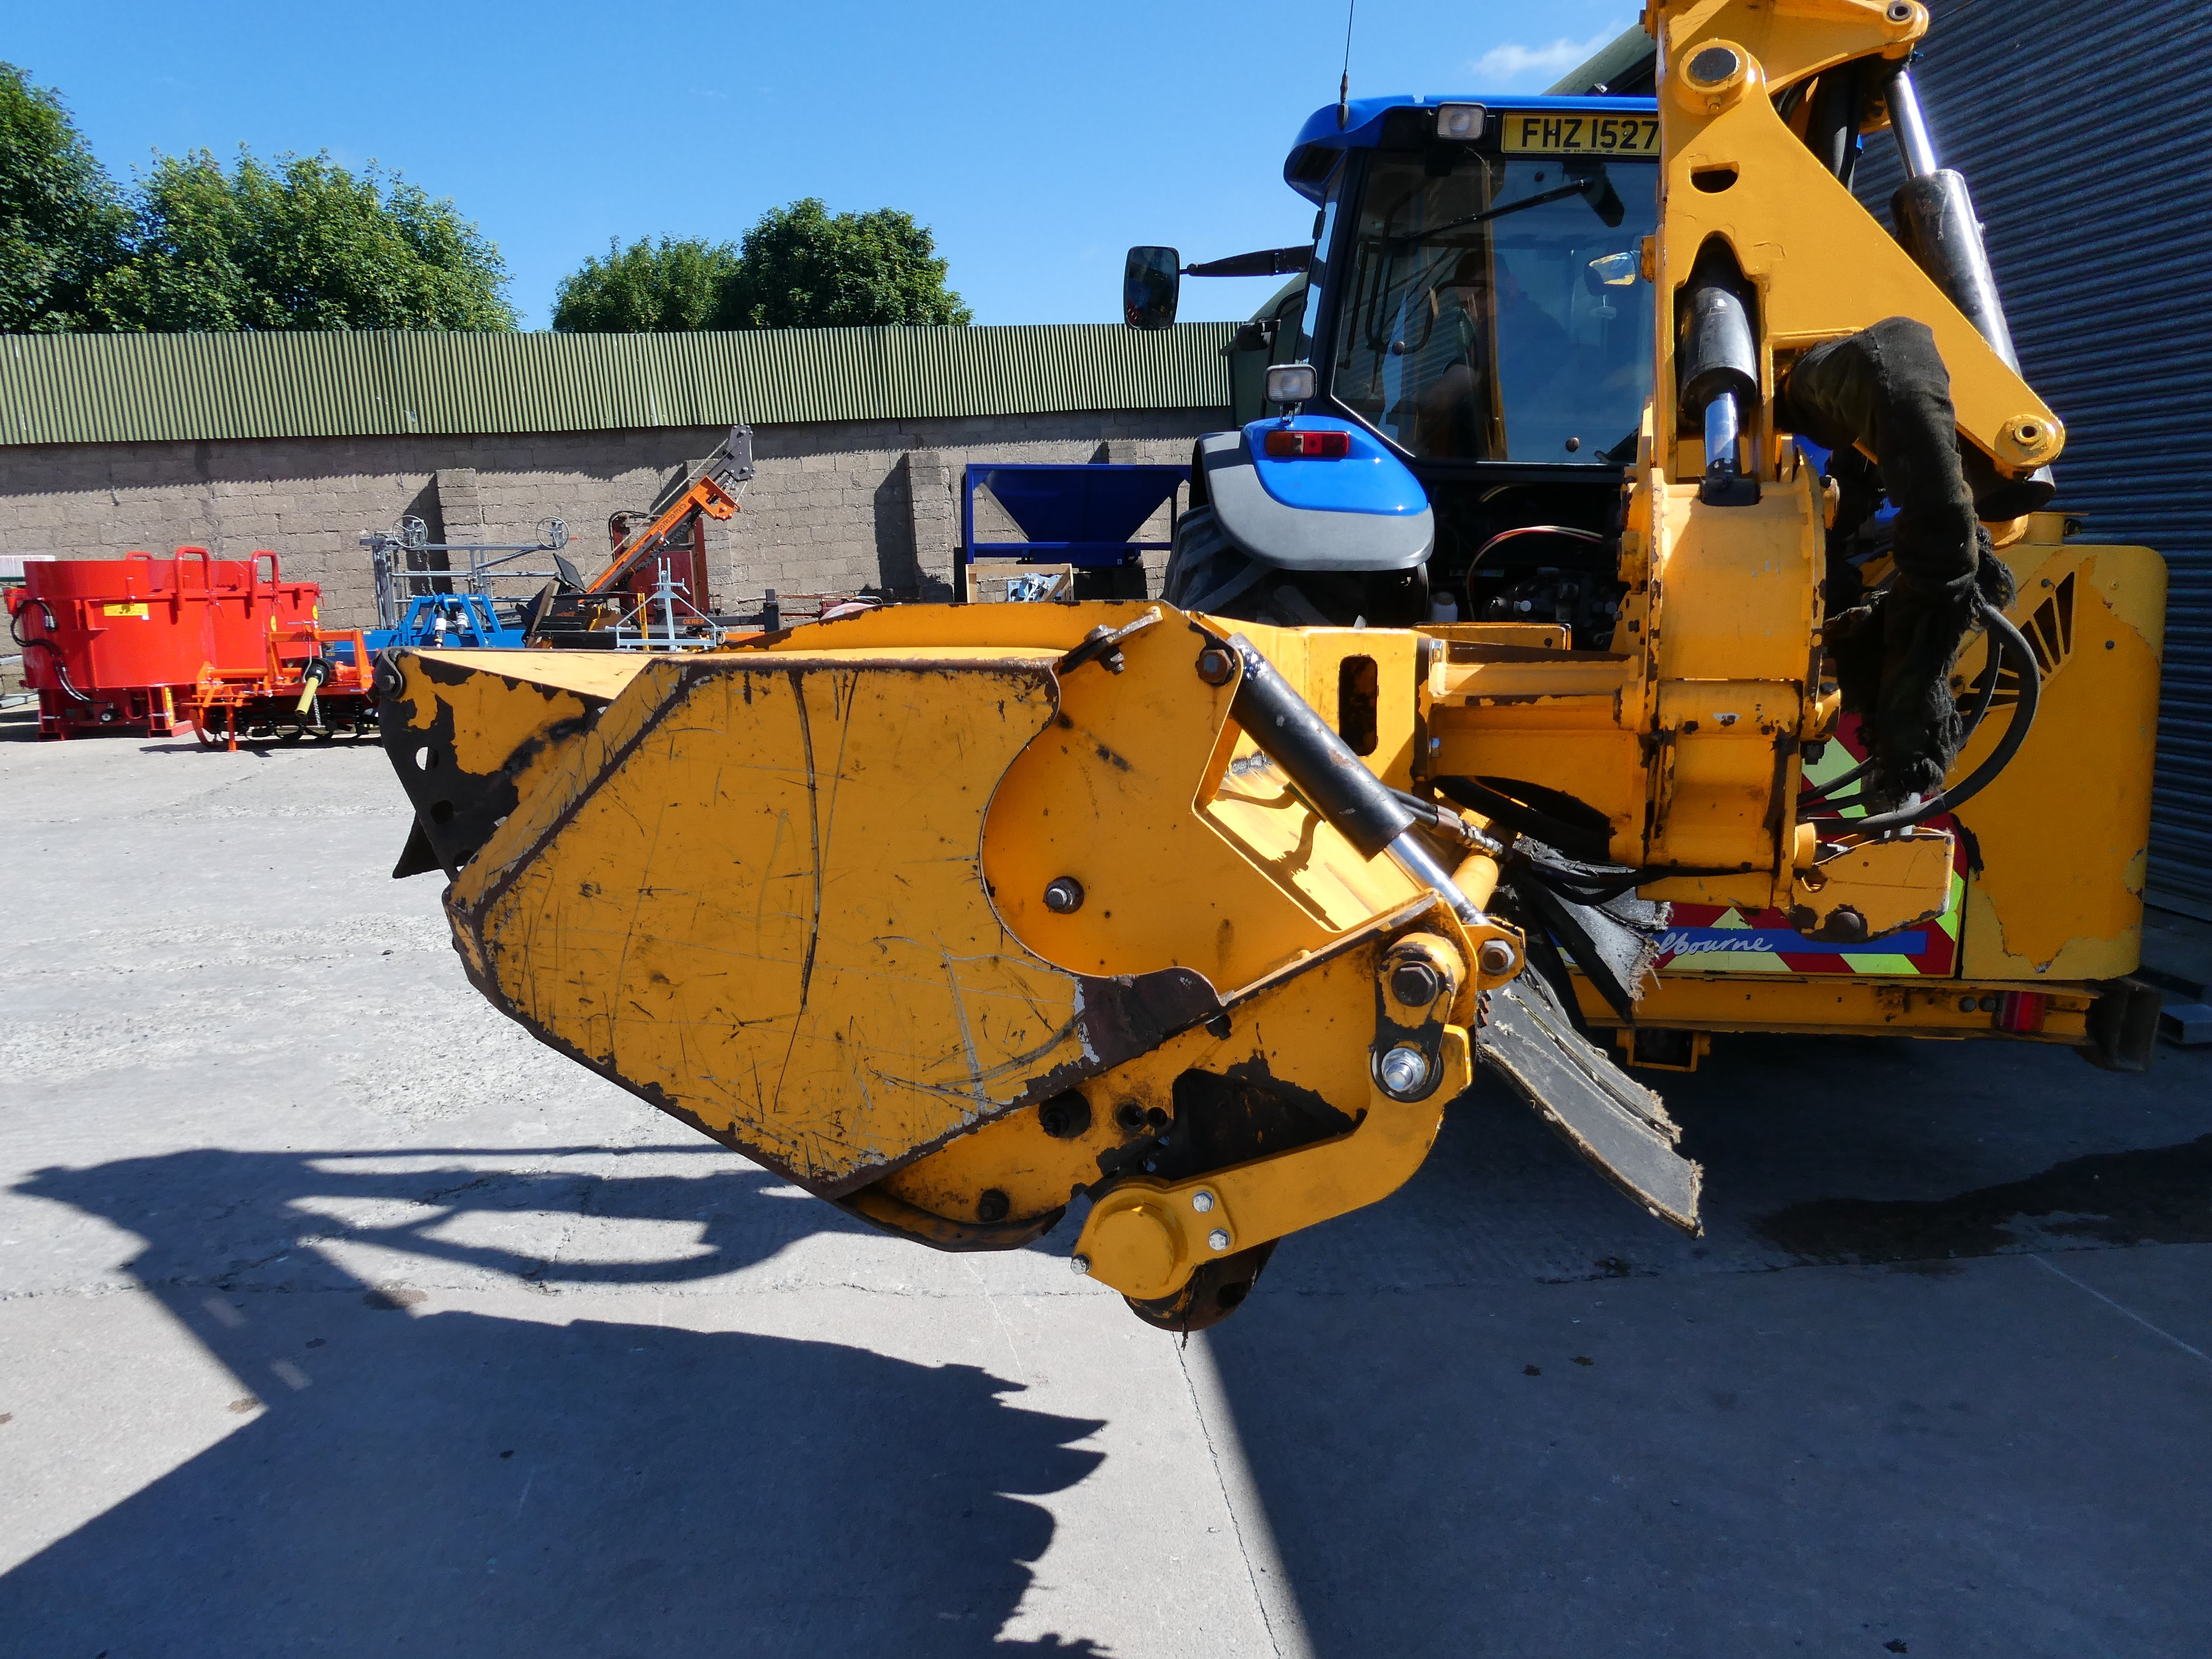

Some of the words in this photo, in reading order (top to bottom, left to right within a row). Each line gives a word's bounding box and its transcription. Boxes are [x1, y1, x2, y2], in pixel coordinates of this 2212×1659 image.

[1522, 119, 1583, 148] FHZ
[1591, 119, 1659, 150] 1527
[1657, 932, 1773, 955] lbourne
